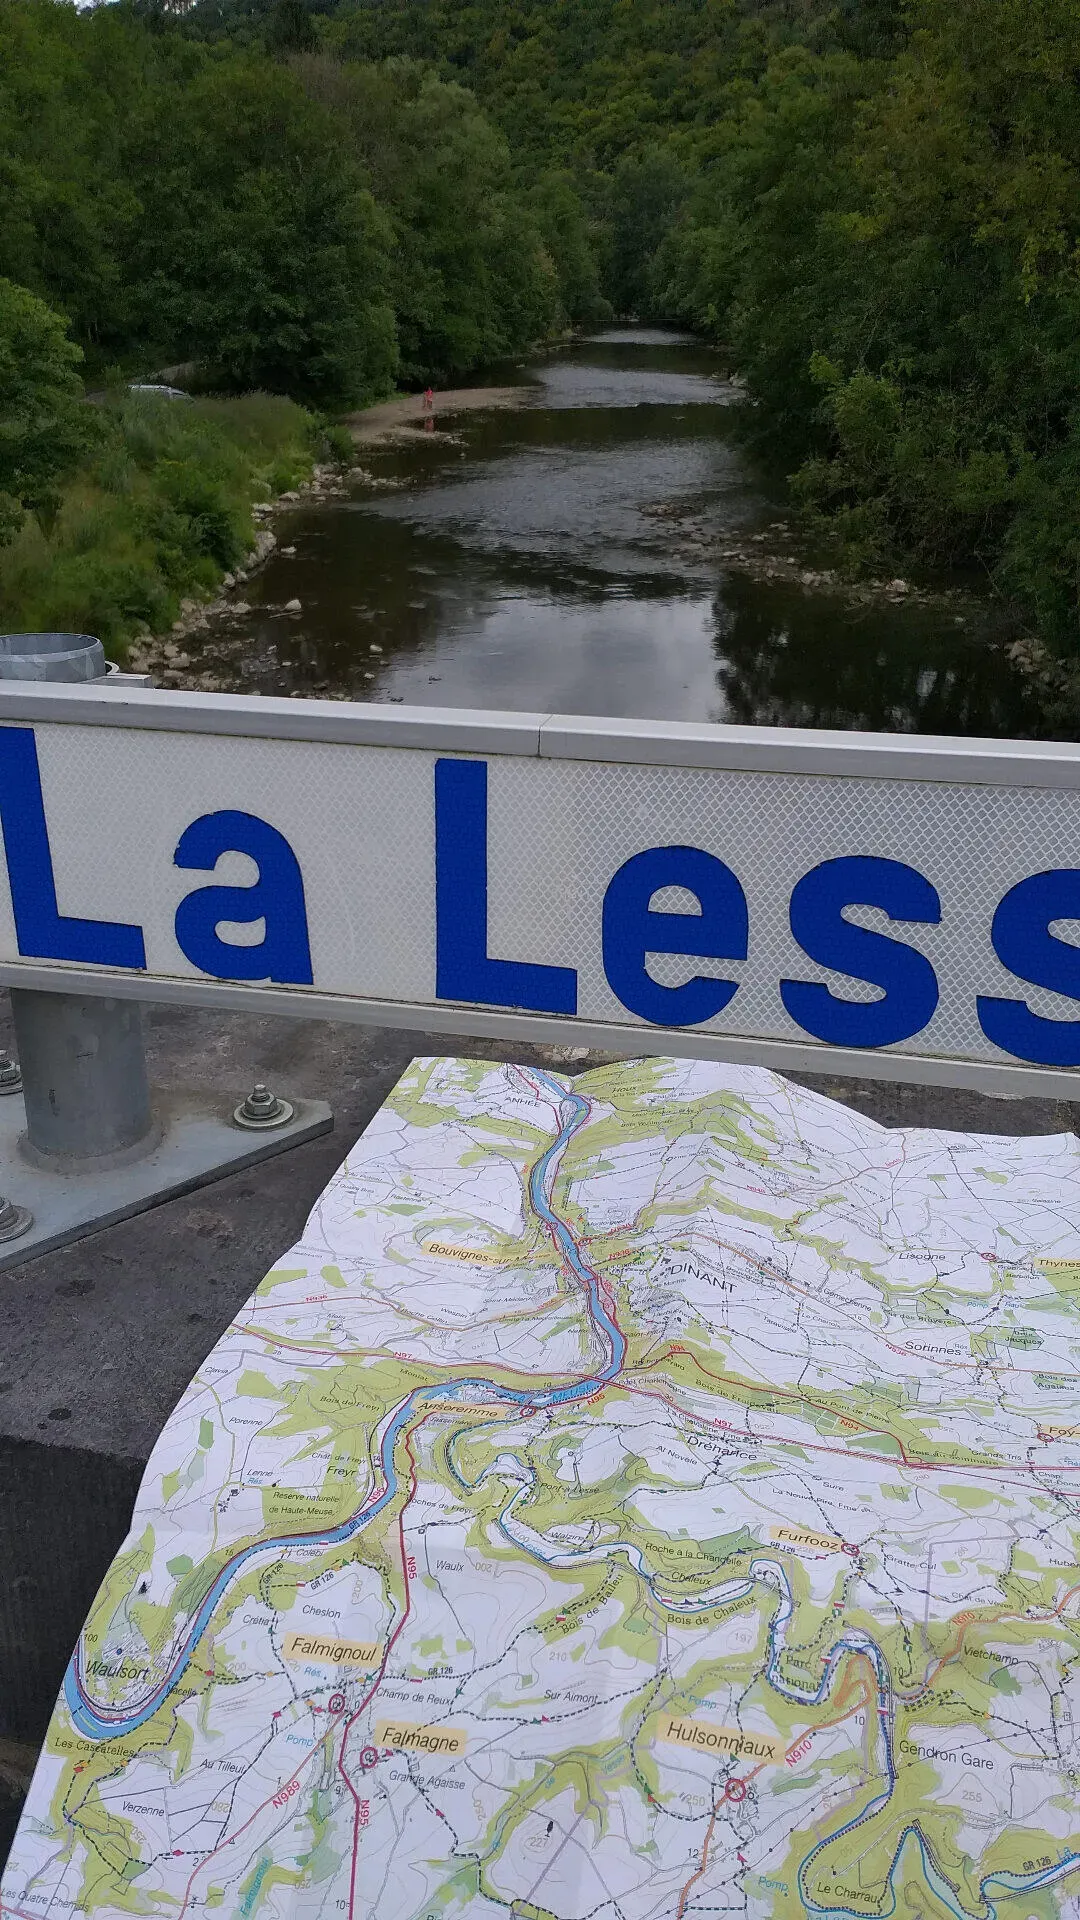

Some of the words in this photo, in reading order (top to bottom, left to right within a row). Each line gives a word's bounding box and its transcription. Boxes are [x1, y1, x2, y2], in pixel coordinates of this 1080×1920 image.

[0, 726, 314, 985] La
[435, 757, 1080, 1067] Less
[670, 1263, 738, 1293] DINANT
[904, 1342, 962, 1356] Sorinnes
[713, 1418, 733, 1429] N97
[326, 1465, 357, 1478] Freyr
[777, 1529, 839, 1551] Furfooz
[645, 1542, 674, 1555] Roche
[684, 1550, 693, 1558] la
[407, 1556, 417, 1580] N95
[435, 1559, 465, 1571] Waulx
[310, 1580, 321, 1591] GR
[320, 1571, 335, 1584] 126
[302, 1604, 341, 1619] Cheslon
[713, 1595, 757, 1619] Chaleux
[561, 1617, 584, 1635] Bois
[586, 1608, 600, 1620] de
[667, 1613, 692, 1624] Bois
[694, 1615, 710, 1626] de
[291, 1637, 378, 1662] Falmignoul
[963, 1646, 1019, 1665] Vietchamp
[85, 1659, 150, 1681] Waulsort
[439, 1666, 453, 1675] 126
[376, 1687, 411, 1700] Champ
[413, 1693, 424, 1702] de
[544, 1689, 561, 1699] Sur
[854, 1715, 865, 1726] 10
[55, 1737, 74, 1749] Les
[76, 1739, 136, 1758] Cascatelles
[382, 1726, 459, 1752] Falmagne
[667, 1721, 776, 1759] Hulsonniaux
[785, 1739, 813, 1769] N910
[899, 1740, 956, 1764] Gendron
[961, 1752, 994, 1770] Gare
[200, 1758, 215, 1770] Au
[217, 1760, 245, 1774] Tilleul
[389, 1770, 425, 1785] Grande
[427, 1774, 467, 1790] Agaisse
[272, 1780, 301, 1809] N989
[961, 1790, 982, 1803] 255
[122, 1800, 165, 1817] Verzenne
[360, 1799, 370, 1826] N95
[688, 1848, 699, 1858] 12
[1022, 1860, 1035, 1871] GR
[1036, 1855, 1052, 1867] 126
[1, 1889, 17, 1900] Les
[18, 1890, 48, 1905] Quatre
[817, 1881, 831, 1895] Le
[834, 1884, 877, 1904] Charrau
[335, 1899, 346, 1910] 10
